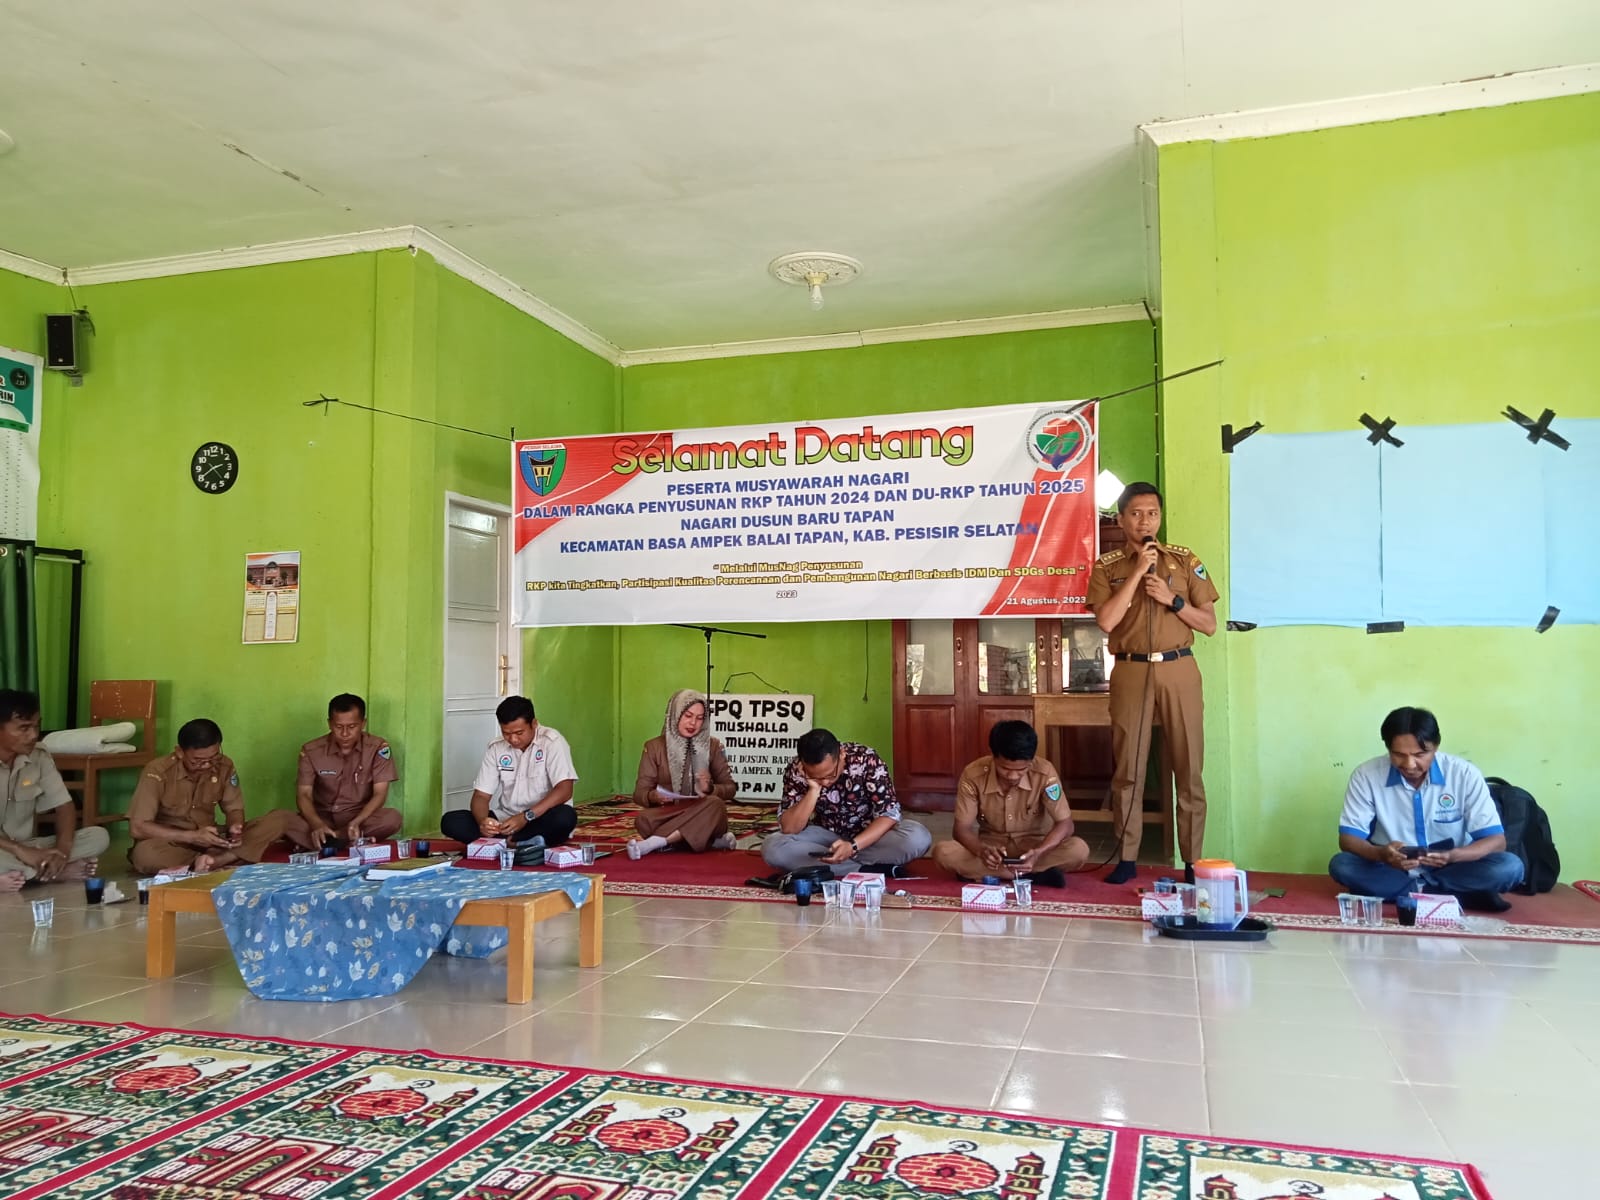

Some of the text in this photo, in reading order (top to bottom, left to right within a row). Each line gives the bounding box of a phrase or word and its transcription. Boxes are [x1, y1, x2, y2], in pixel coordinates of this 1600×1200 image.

[210, 445, 219, 453] 12
[612, 425, 973, 474] Selamat Datang
[667, 472, 909, 496] PESERTA MUSYAWARAH NAGARI
[524, 480, 1084, 518] DALAM RANGKA PENYUSUNAN RKP TAHUN 2024 DAN DU-RKP TAHUN 2025
[681, 510, 894, 530] NAGARI DUSUN BARU TAPAN
[560, 522, 1038, 553] KECAMATAN BASA AMPEK BALAI TAPAN, KAB. PESISIR SELATAN
[758, 561, 799, 573] MusNag
[800, 560, 863, 571] Penyusunan
[526, 581, 546, 591] RKP
[548, 581, 566, 590] kita
[621, 577, 673, 588] Partisipasi
[675, 576, 715, 587] Kualitas
[716, 574, 780, 585] Perencanaan
[782, 574, 801, 583] dan
[803, 572, 877, 583] Pembangunan
[878, 570, 913, 582] Nagari
[915, 568, 963, 579] Berbasis
[965, 568, 987, 578] IDM
[989, 567, 1011, 577] Dan
[1013, 566, 1045, 577] SDGs
[776, 590, 797, 598] 2023
[1007, 597, 1018, 605] 21
[1063, 596, 1086, 604] 2023
[749, 700, 805, 721] TPSQ
[715, 721, 788, 732] MUSHALLA
[742, 766, 772, 775] AMPEK
